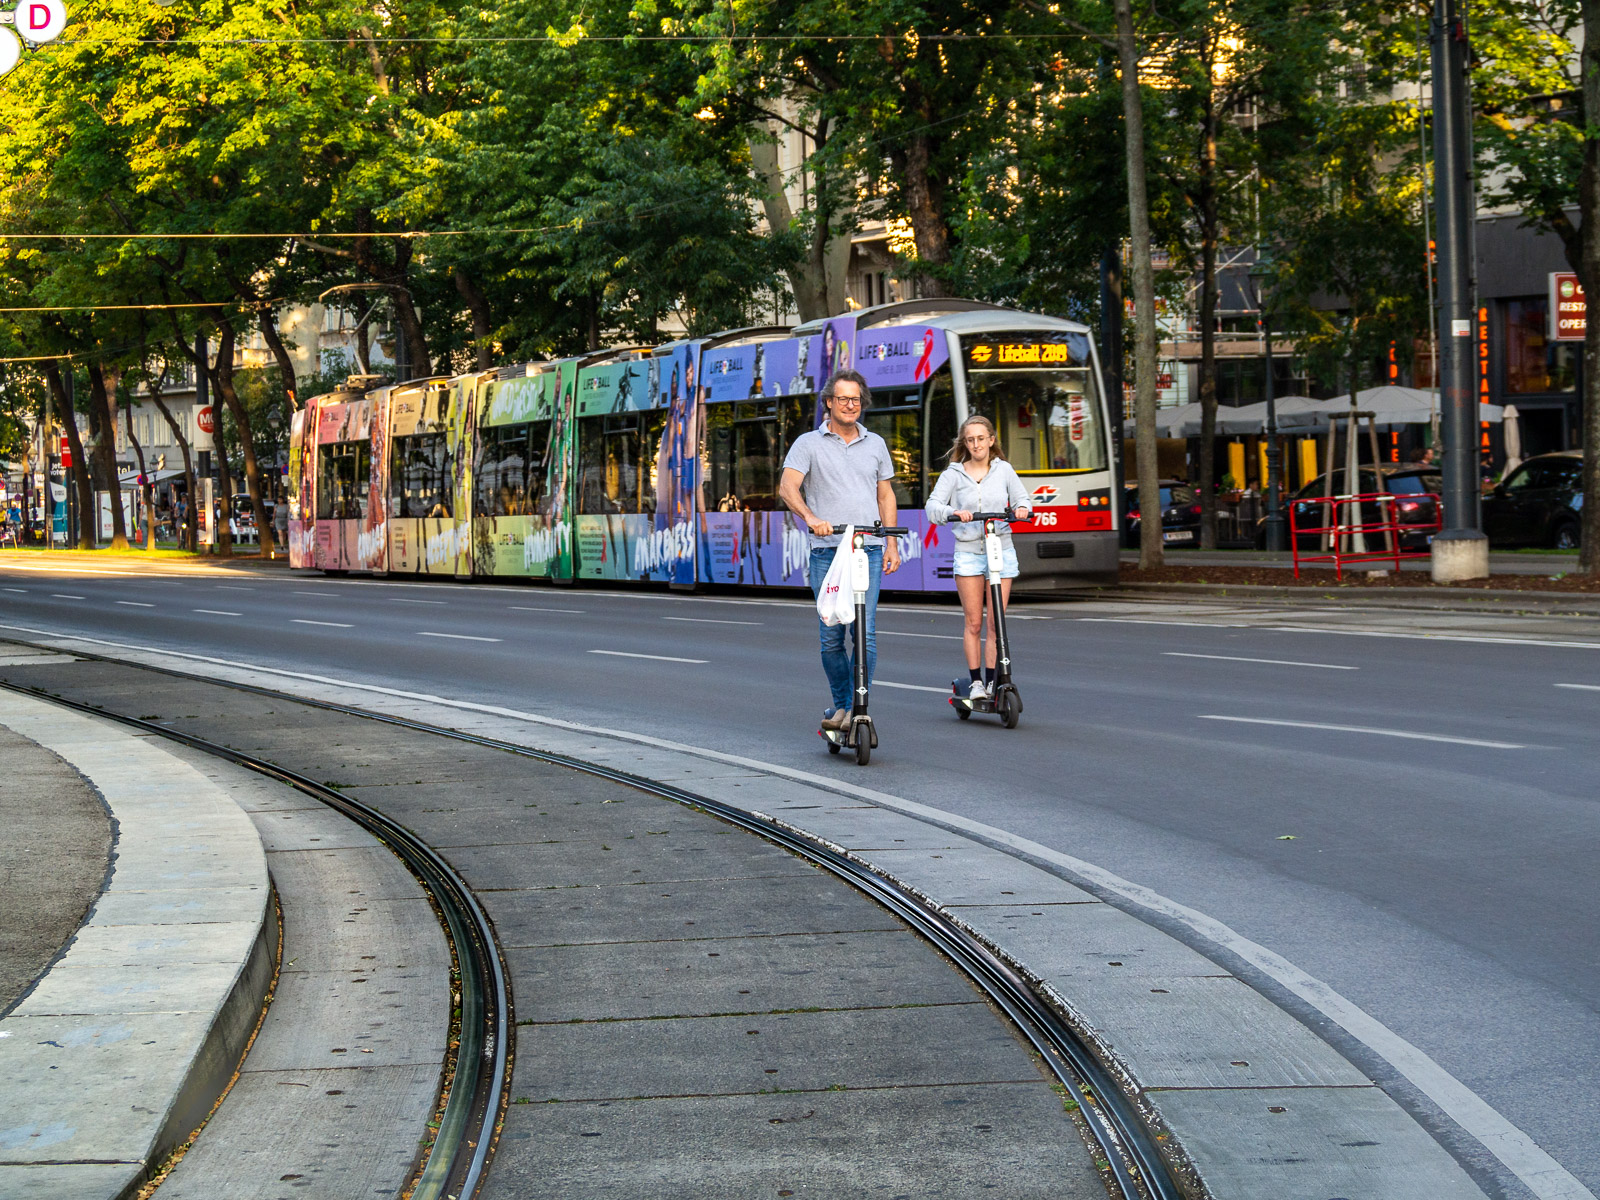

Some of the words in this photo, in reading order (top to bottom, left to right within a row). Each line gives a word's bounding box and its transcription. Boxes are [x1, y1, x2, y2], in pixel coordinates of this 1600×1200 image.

[29, 3, 51, 30] D
[859, 344, 878, 360] LIFE
[887, 341, 910, 358] BALL
[709, 360, 723, 375] LIFE
[728, 357, 743, 372] BALL
[583, 377, 594, 391] LIFE
[598, 376, 610, 389] BALL
[1478, 307, 1490, 453] RESTAA
[117, 464, 131, 475] tel
[1033, 511, 1058, 527] 766
